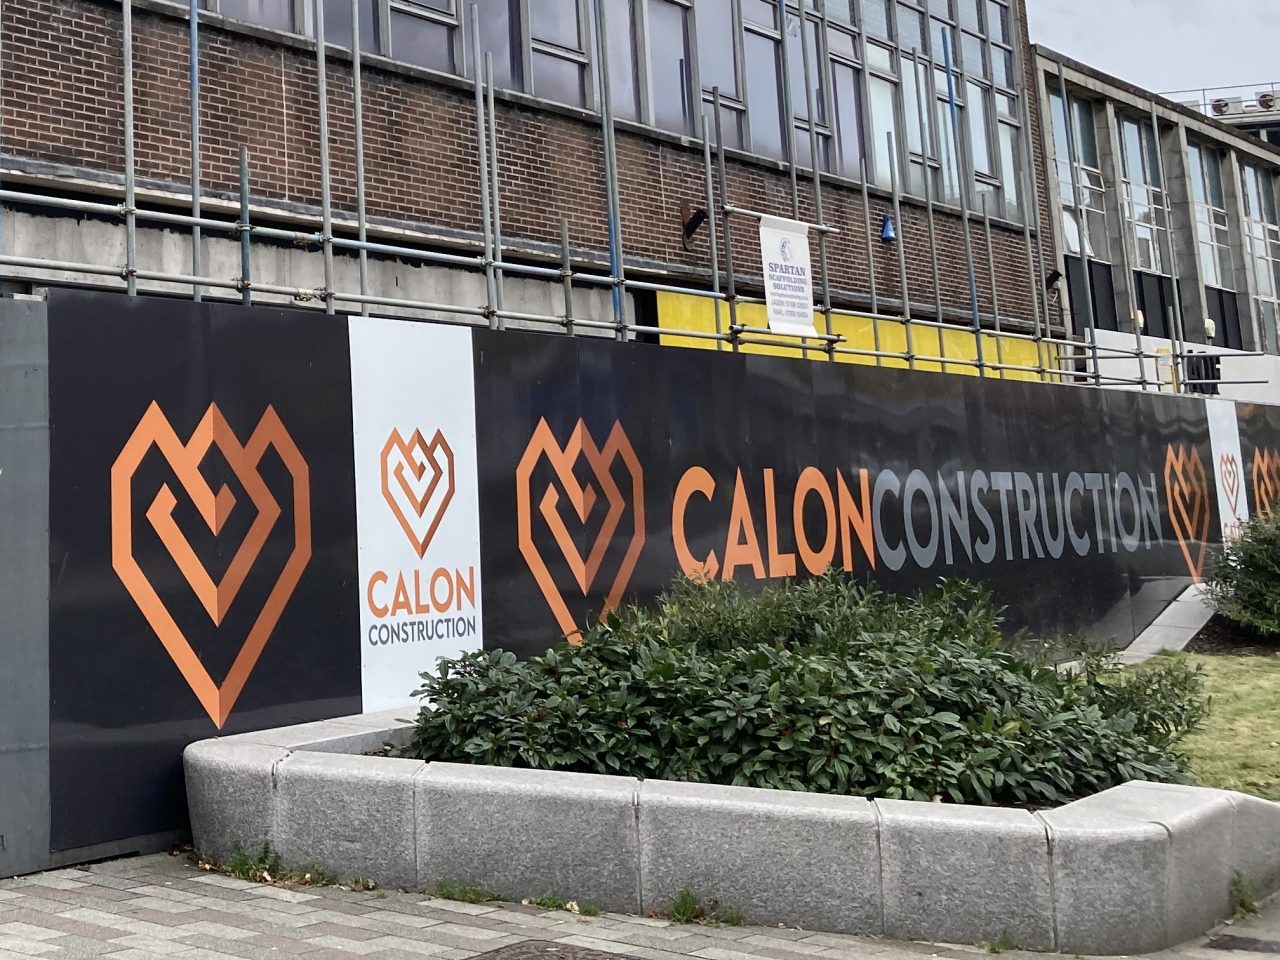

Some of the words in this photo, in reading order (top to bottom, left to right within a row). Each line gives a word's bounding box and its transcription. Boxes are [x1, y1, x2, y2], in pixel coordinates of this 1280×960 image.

[768, 262, 806, 276] SPARTAN
[768, 273, 807, 285] SCAFFOLDING
[772, 282, 805, 293] SOLUTIONS
[367, 566, 476, 619] CALON
[368, 615, 477, 647] CONSTRUCTION
